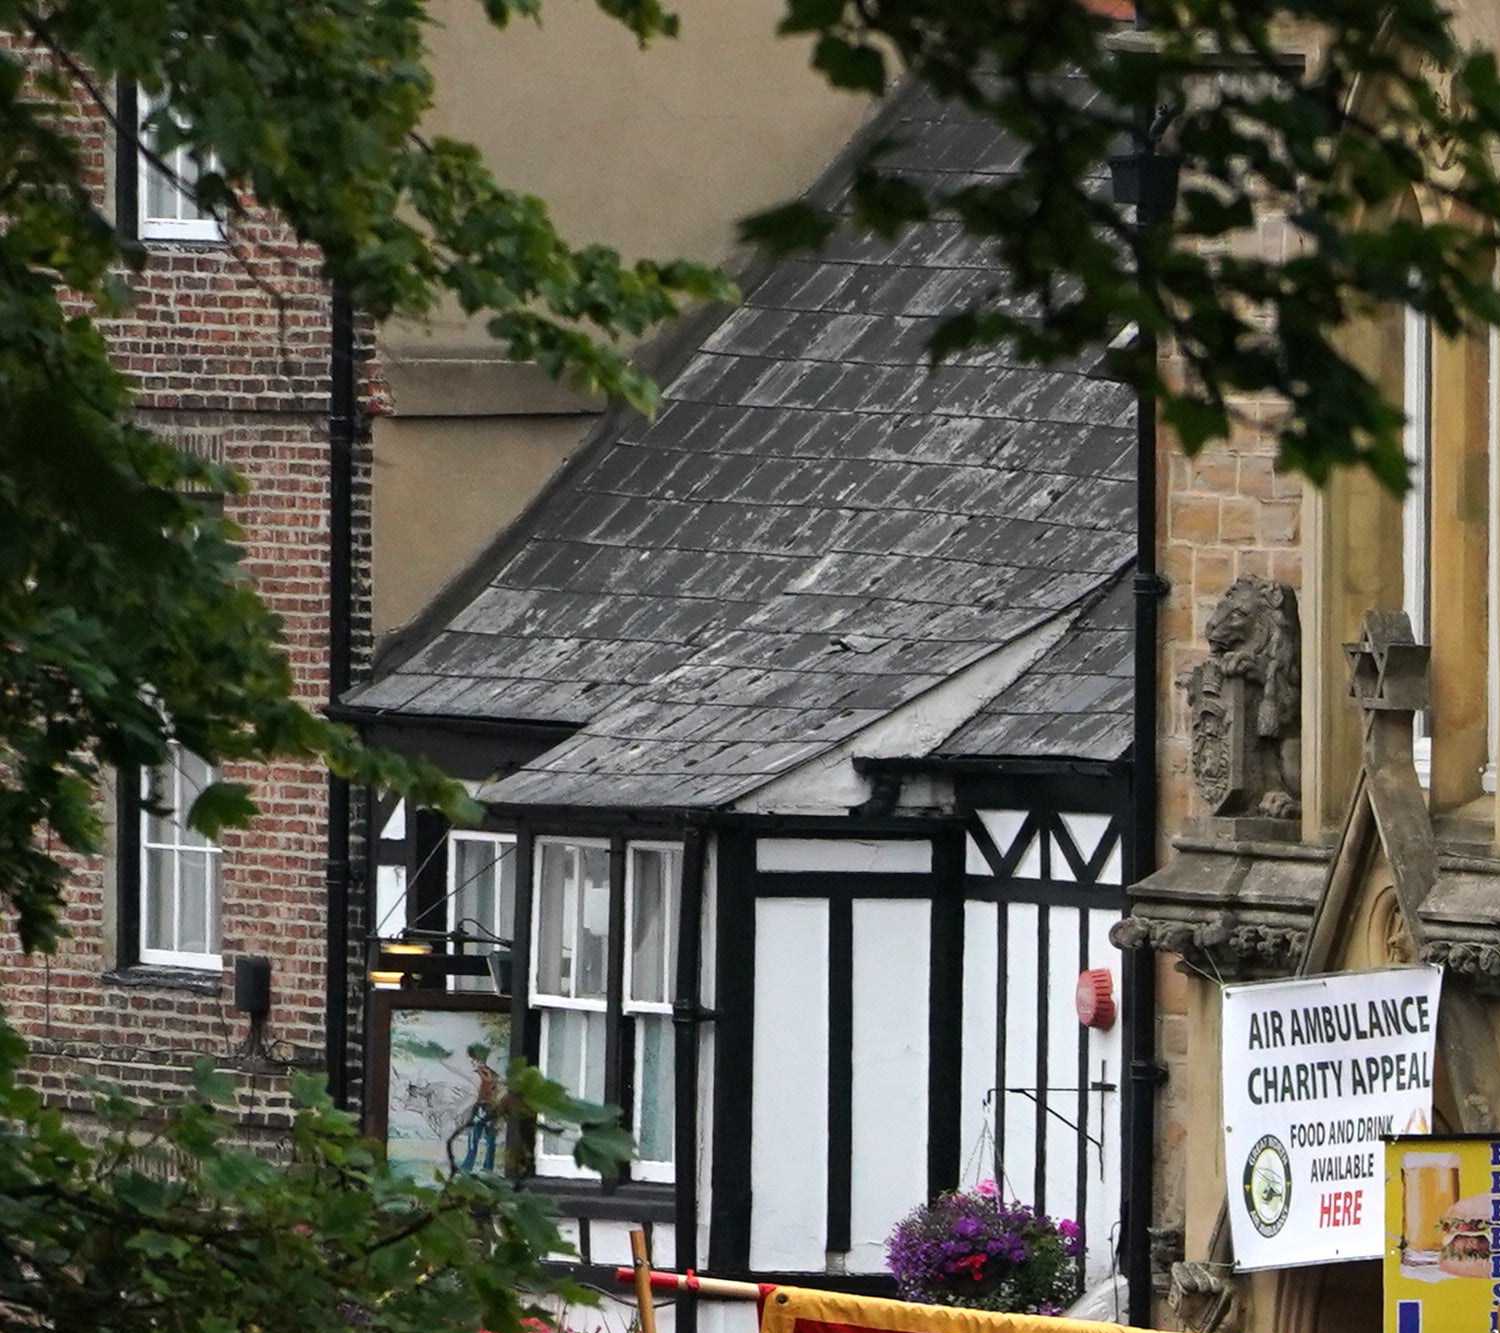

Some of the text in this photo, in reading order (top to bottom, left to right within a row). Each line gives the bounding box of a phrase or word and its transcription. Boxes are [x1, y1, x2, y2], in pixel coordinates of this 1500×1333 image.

[1249, 995, 1430, 1050] AIR AMBULANCE
[1248, 1051, 1431, 1105] CHARITY APPEAL
[1290, 1114, 1394, 1148] FOOD AND DRINK
[1310, 1153, 1374, 1184] AVAILABLE
[1320, 1189, 1363, 1229] HERE
